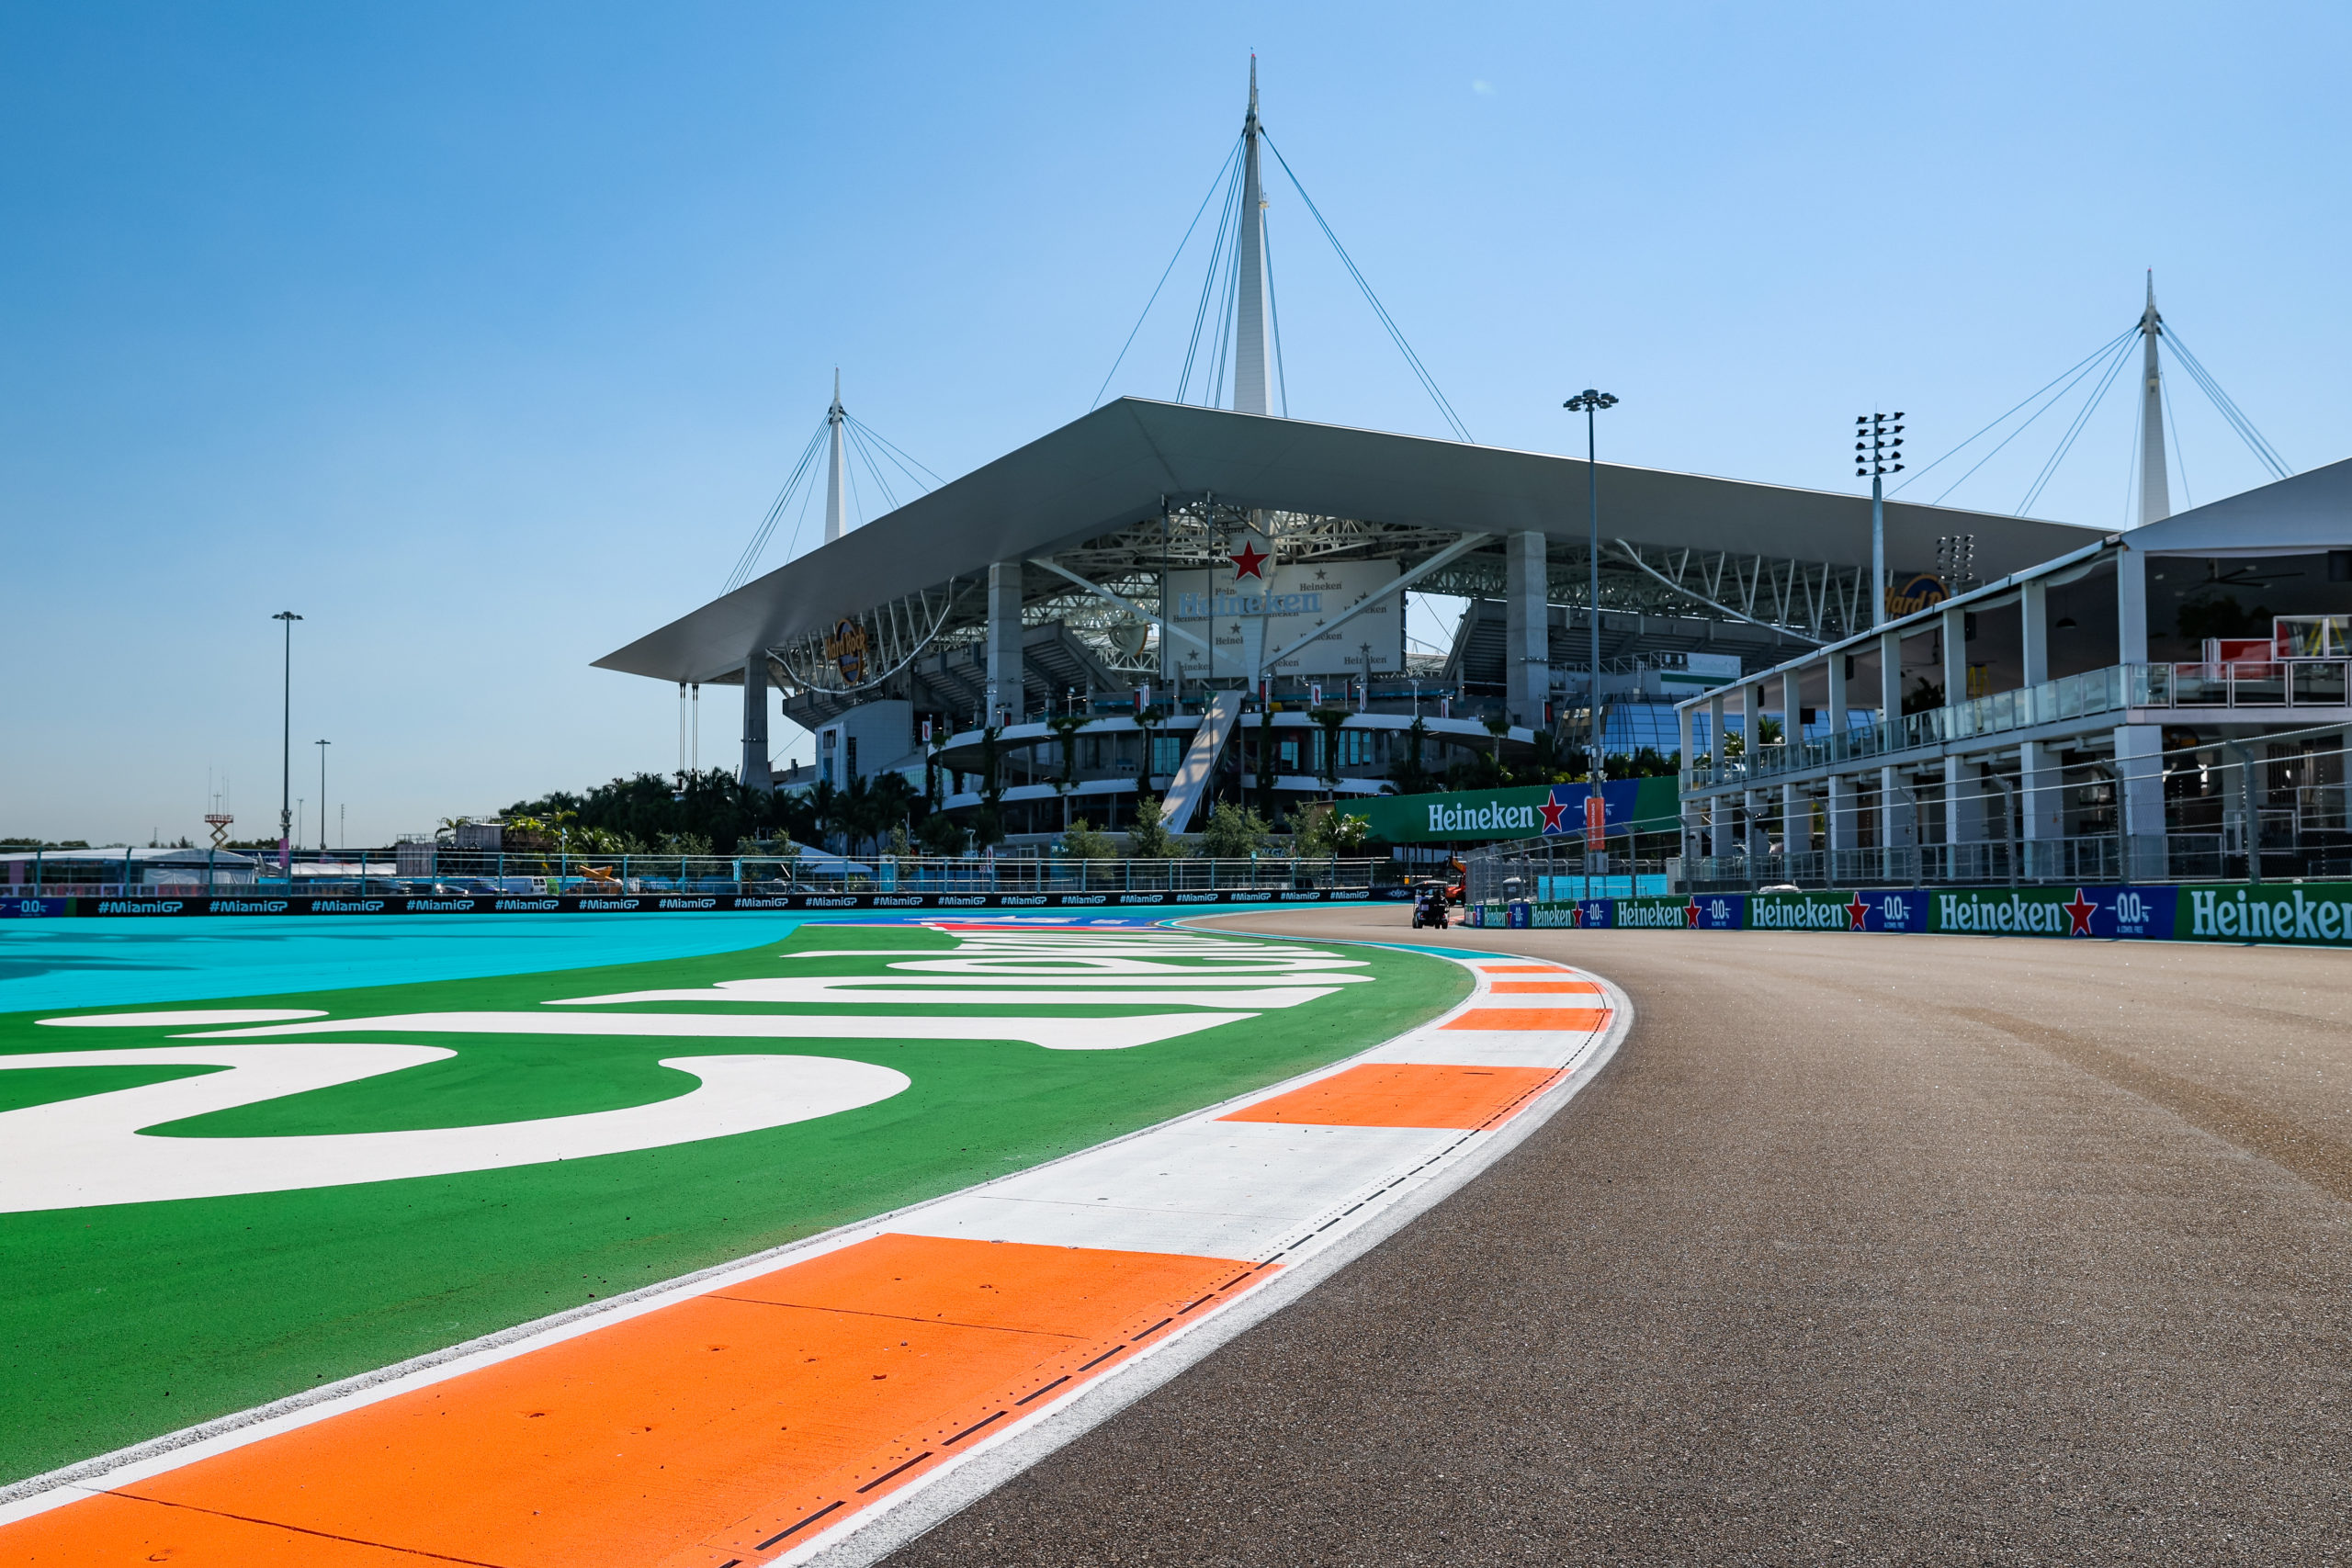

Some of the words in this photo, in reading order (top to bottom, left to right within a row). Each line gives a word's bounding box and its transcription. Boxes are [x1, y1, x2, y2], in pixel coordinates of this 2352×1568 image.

[1300, 581, 1342, 592] Heineken
[1179, 589, 1322, 617] Heineken
[825, 632, 845, 660] Hard
[844, 626, 869, 657] Rock
[1428, 801, 1534, 831] Heineken
[98, 901, 183, 914] #MiamiGP
[209, 900, 288, 912] #MiamiGP
[311, 900, 384, 912] #MiamiGP
[407, 899, 474, 911] #MiamiGP
[495, 899, 559, 910] #MiamiGP
[579, 899, 639, 910] #MiamiGP
[659, 898, 716, 908] #MiamiGP
[734, 897, 788, 908] #MiamiGP
[806, 897, 857, 907] #MiamiGP
[874, 897, 922, 906] #MiamiGP
[938, 897, 986, 906] #MiamiGP
[1001, 897, 1046, 905] #MiamiGP
[1062, 896, 1106, 904] #MiamiGP
[1120, 895, 1163, 904] #MiamiGP
[1177, 894, 1218, 902] #MiamiGP
[1231, 893, 1271, 901] #MiamiGP
[1281, 892, 1320, 900] #MiamiGP
[1330, 892, 1369, 900] #MiamiGP
[1532, 904, 1571, 927] Heineken
[1618, 900, 1683, 927] Heineken
[1751, 897, 1844, 928] Heineken
[1939, 894, 2063, 931] Heineken
